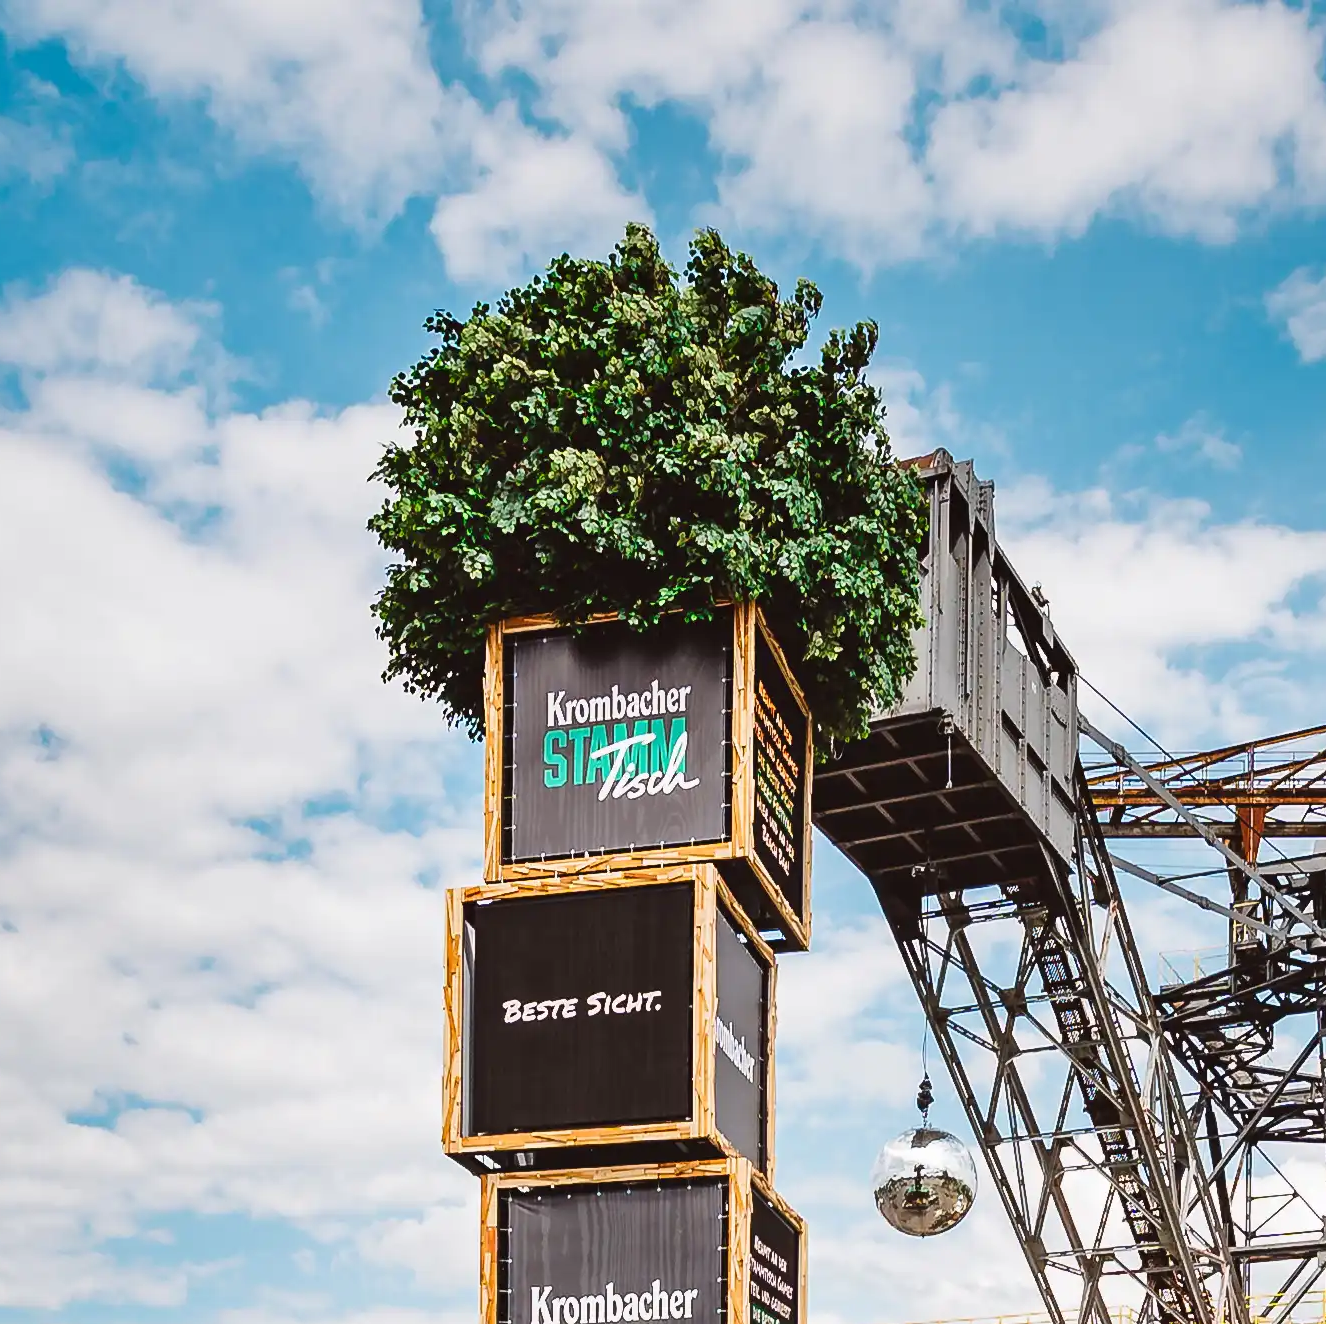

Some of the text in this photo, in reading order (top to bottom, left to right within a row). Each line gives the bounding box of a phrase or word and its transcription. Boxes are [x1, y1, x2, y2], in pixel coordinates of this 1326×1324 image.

[547, 679, 692, 727] Krombacher
[543, 717, 687, 789] STAMM
[590, 731, 700, 801] Tisch
[502, 990, 662, 1023] BESTE SICHT.
[716, 1016, 756, 1083] rombacher
